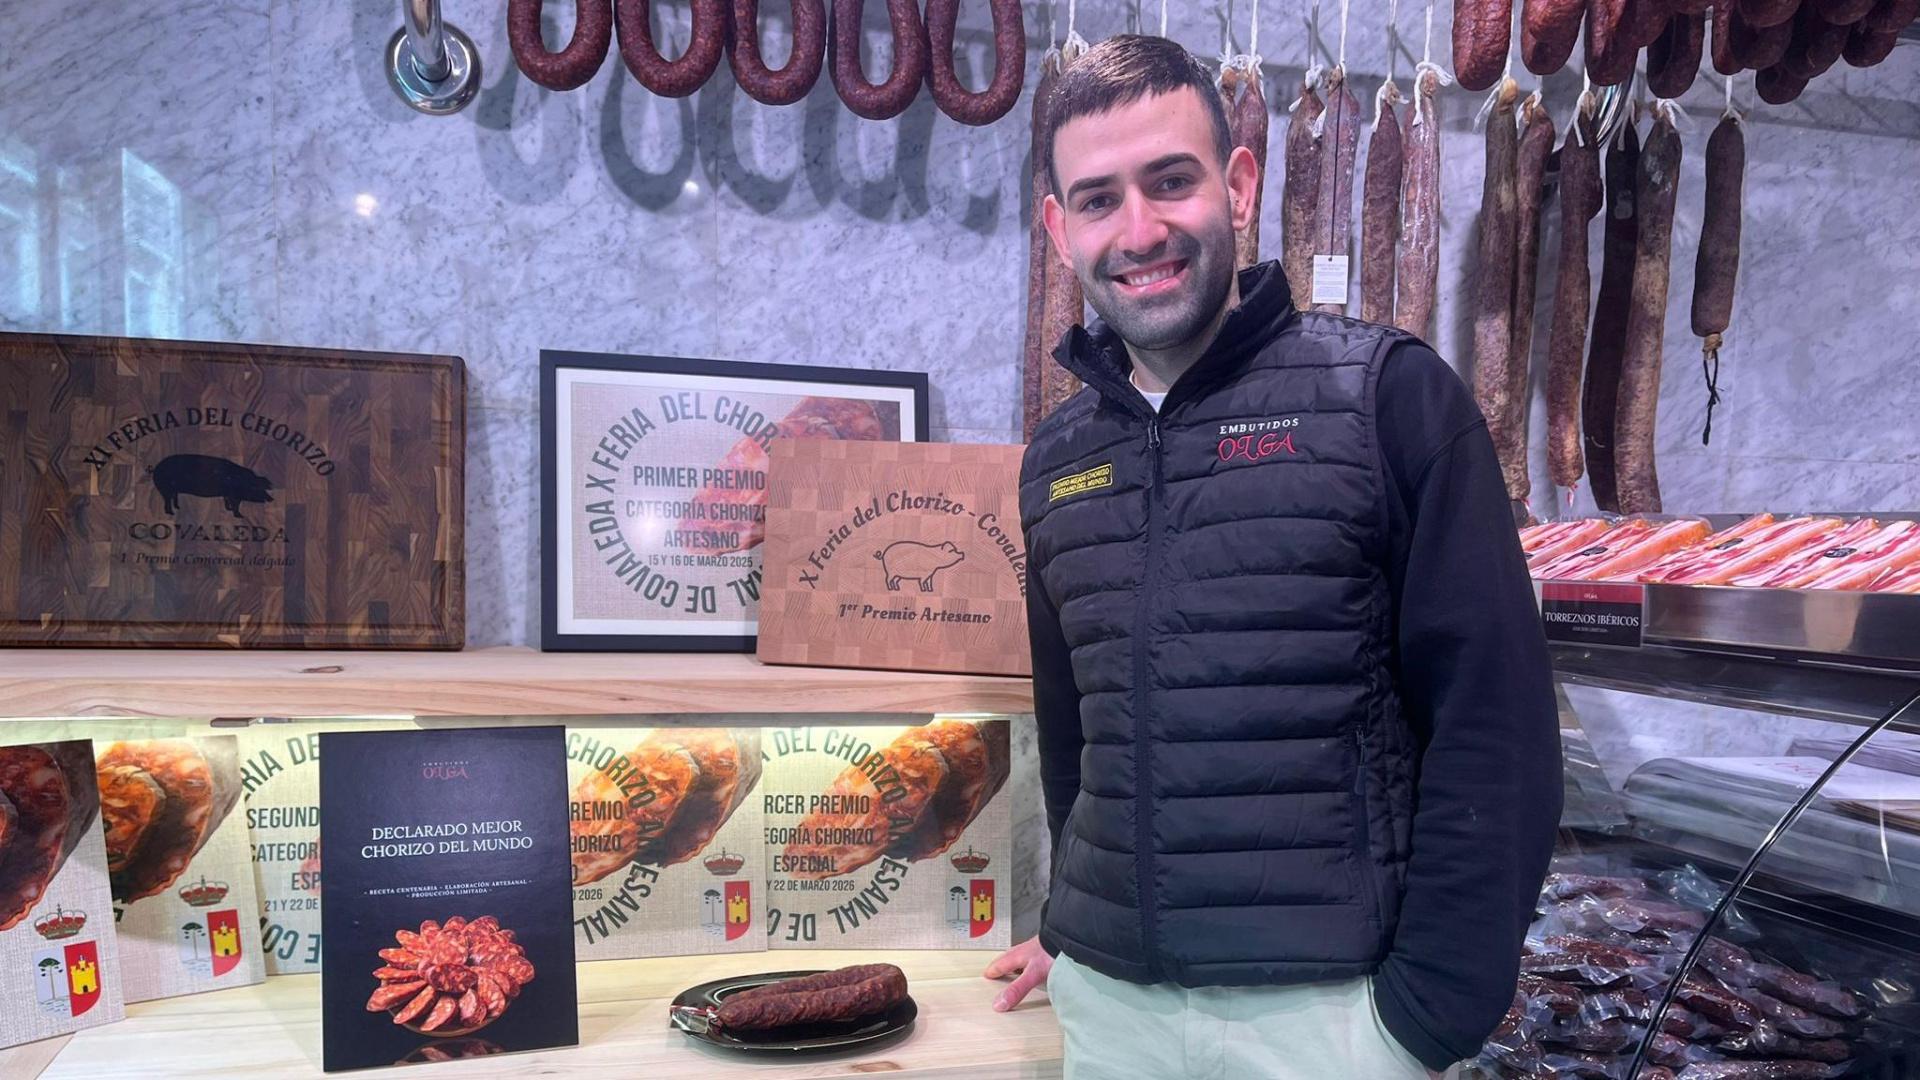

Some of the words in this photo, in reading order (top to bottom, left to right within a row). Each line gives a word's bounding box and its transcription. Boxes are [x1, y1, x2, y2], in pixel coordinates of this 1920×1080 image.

[658, 392, 707, 423] DEL
[713, 395, 778, 457] CHOR
[1219, 418, 1299, 434] EMBUTIDOS
[83, 444, 112, 472] XI
[107, 411, 180, 450] FERIA
[186, 407, 233, 428] DEL
[239, 412, 336, 477] CHORIZO
[591, 408, 656, 472] FERIA
[1217, 431, 1297, 463] OLGA
[585, 473, 616, 493] X
[633, 465, 698, 488] PRIMER
[703, 468, 766, 491] PREMIO
[626, 499, 705, 520] CATEGORÍA
[852, 498, 882, 529] del
[886, 490, 965, 516] Chorizo
[128, 522, 290, 544] COVALEDA
[664, 530, 740, 549] ARTESANO
[585, 499, 680, 608] COVALEDA
[808, 525, 852, 571] Feria
[135, 552, 181, 566] Premio
[183, 553, 245, 566] Comercial
[648, 555, 660, 566] 15
[660, 555, 667, 566] Y
[670, 555, 681, 566] 16
[684, 556, 694, 567] DE
[697, 556, 728, 567] MARZO
[730, 556, 753, 568] 2025
[799, 569, 819, 589] X
[685, 585, 717, 614] DE
[861, 604, 917, 621] Premio
[920, 607, 992, 624] Artesano
[1545, 612, 1596, 625] TORREZNOS
[1597, 613, 1639, 627] IBÉRICOS
[240, 749, 284, 802] RIA
[566, 732, 657, 810] CHORIZO
[773, 729, 816, 757] DEL
[823, 729, 908, 804] CHORIZO
[810, 795, 870, 814] PREMIO
[372, 822, 468, 841] DECLARADO
[472, 820, 523, 835] MEJOR
[815, 828, 873, 845] CHORIZO
[361, 842, 435, 859] CHORIZO
[439, 840, 469, 854] DEL
[473, 836, 533, 851] MUNDO
[774, 855, 838, 873] ESPECIAL
[369, 887, 396, 896] RECETA
[396, 885, 438, 894] CENTENARIA
[492, 879, 528, 887] ARTESANAL
[456, 887, 488, 896] LIMITADA
[578, 888, 603, 901] 2026
[774, 880, 785, 891] 22
[788, 880, 798, 891] DE
[801, 880, 830, 891] MARZO
[832, 880, 855, 891] 2026
[264, 900, 277, 912] 21
[281, 899, 288, 910] Y
[290, 898, 303, 911] 22
[305, 898, 318, 910] DE
[785, 913, 816, 942] DE
